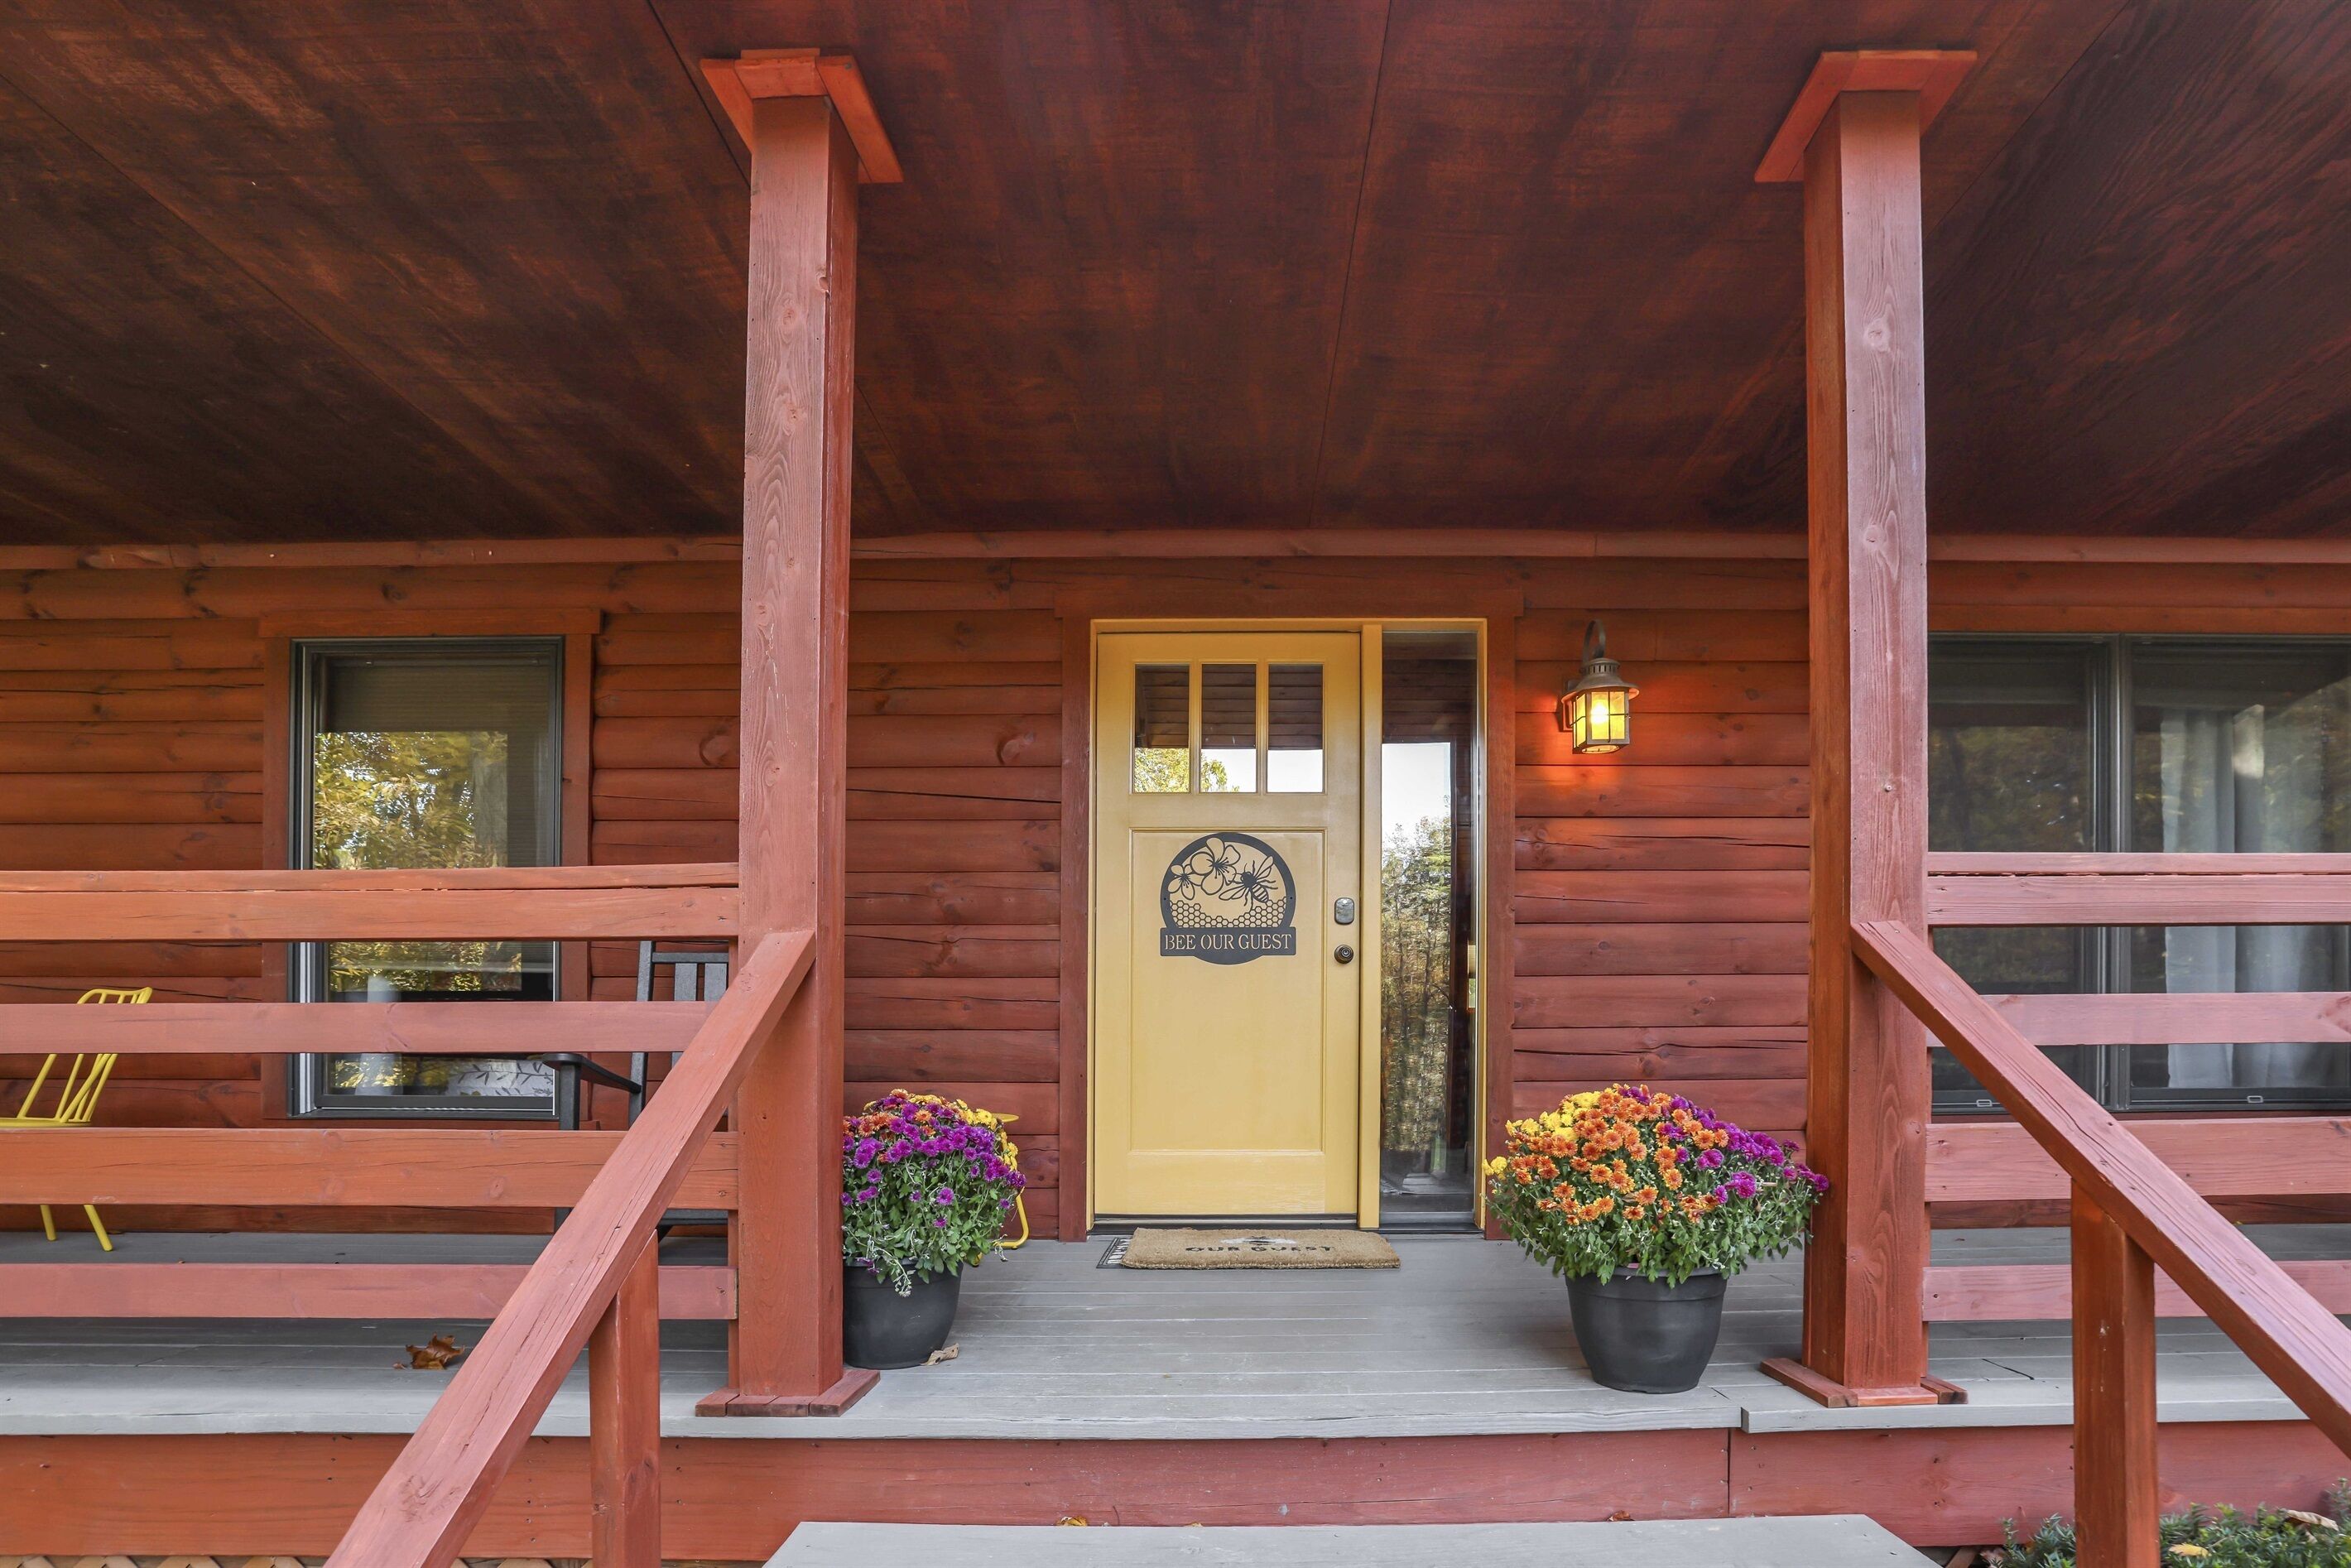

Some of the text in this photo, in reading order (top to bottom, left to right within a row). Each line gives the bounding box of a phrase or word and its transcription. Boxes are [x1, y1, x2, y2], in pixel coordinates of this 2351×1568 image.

[1165, 934, 1292, 950] BEE OUR GUEST
